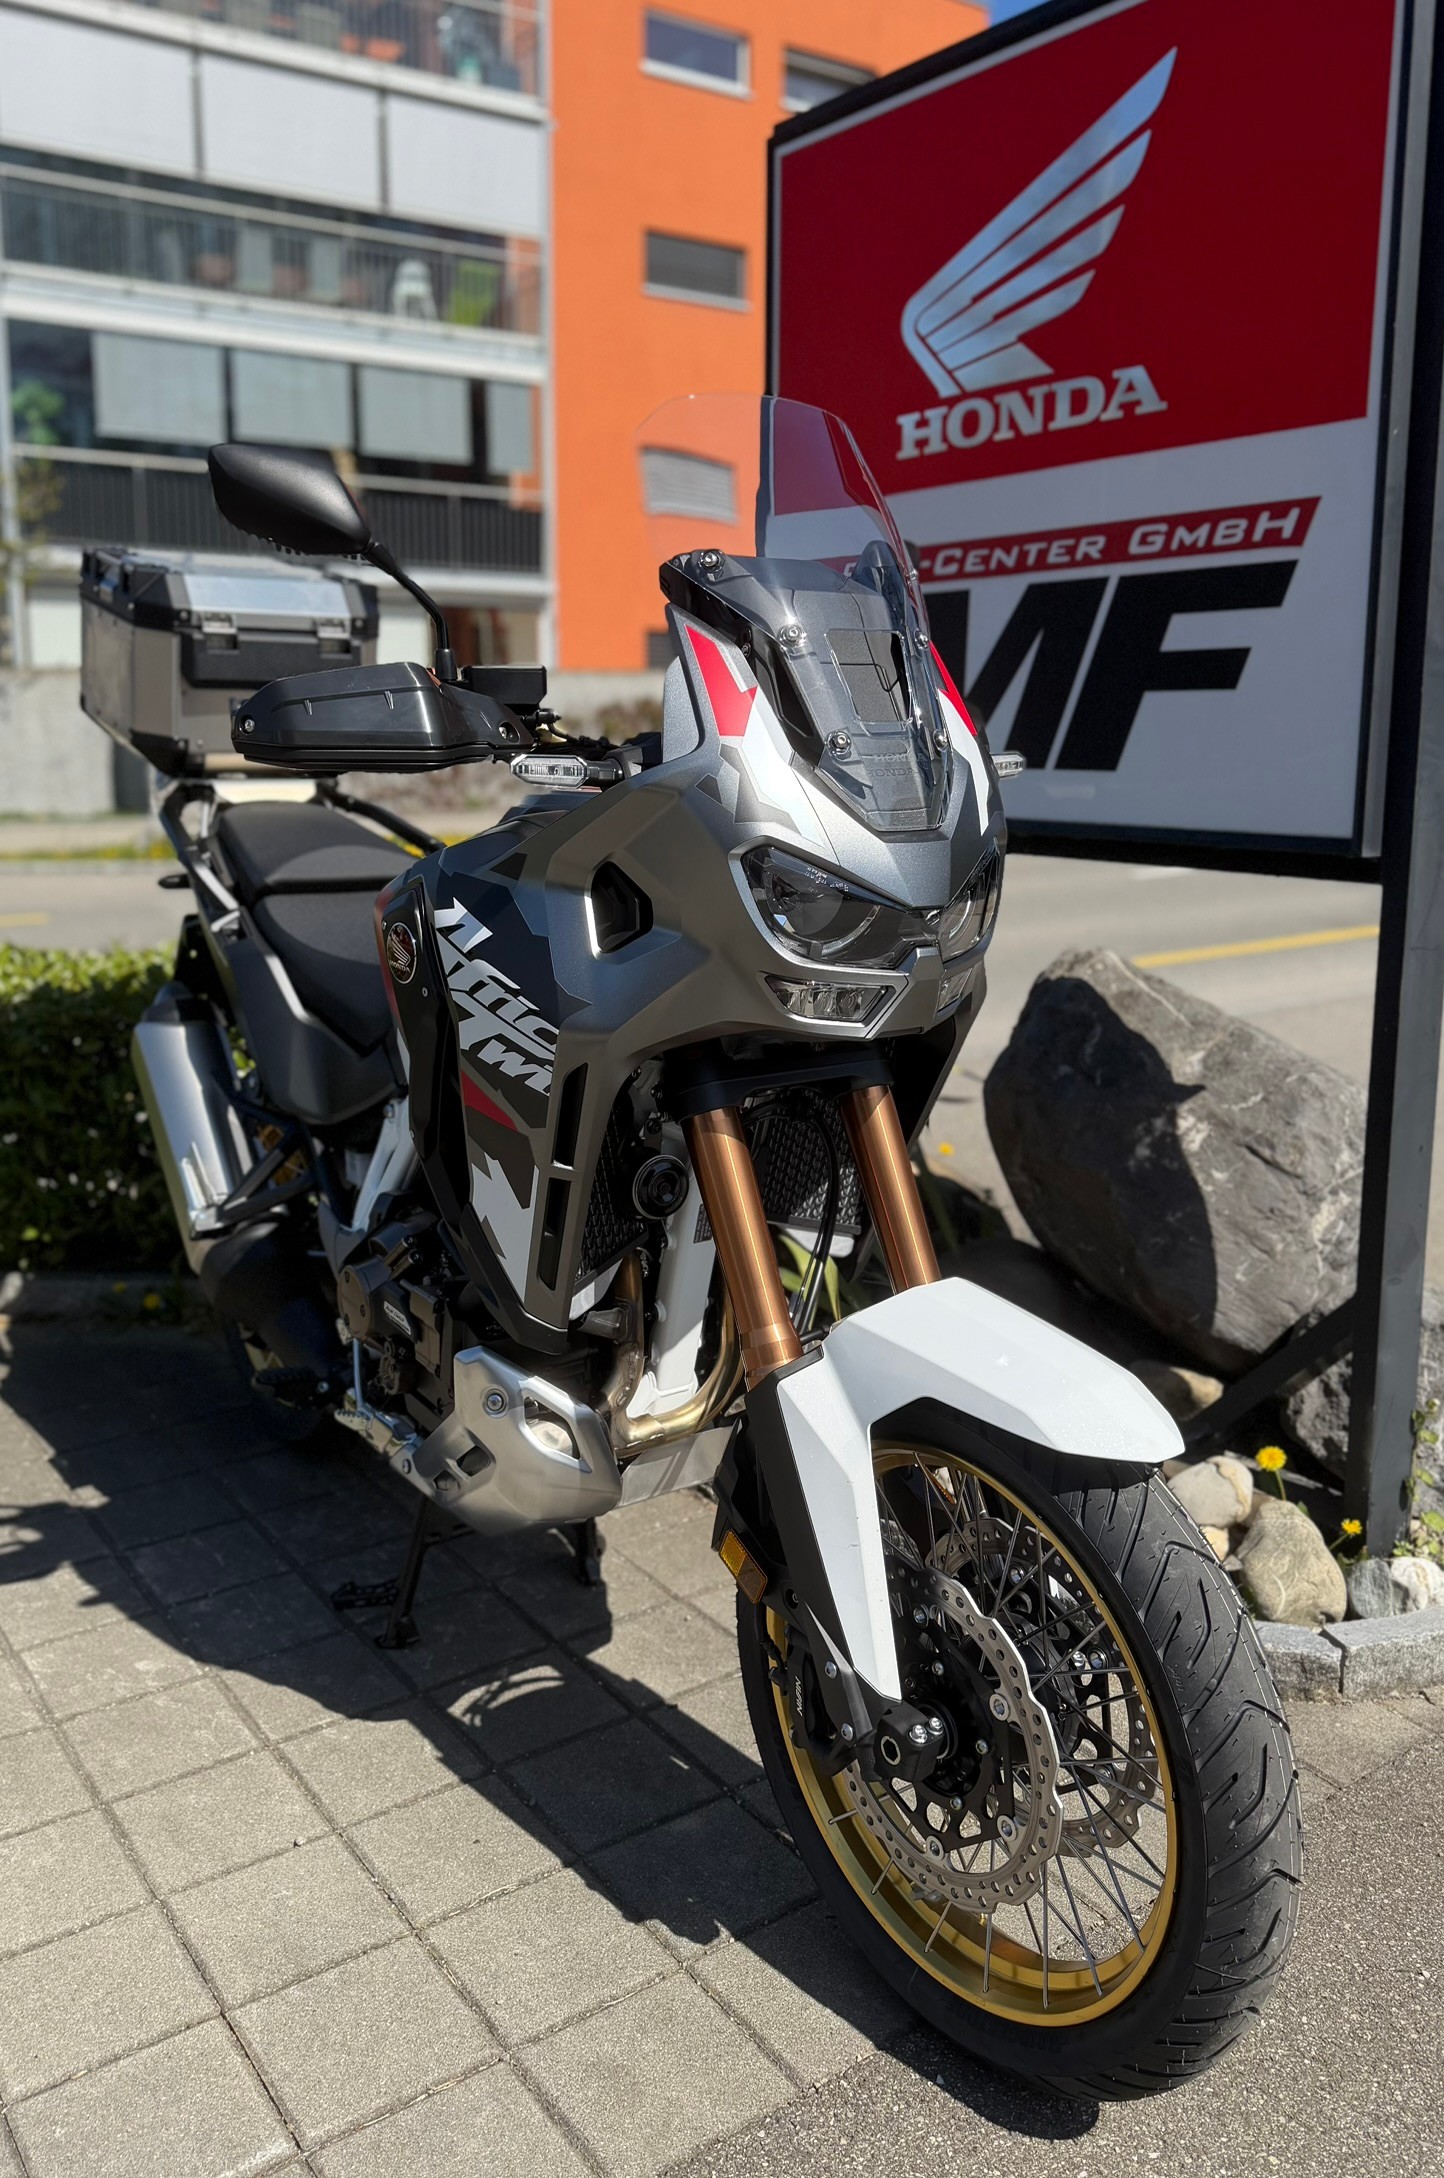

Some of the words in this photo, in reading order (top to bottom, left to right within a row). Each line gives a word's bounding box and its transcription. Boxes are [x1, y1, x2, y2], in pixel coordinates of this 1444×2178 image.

[896, 365, 1168, 460] HONDA
[843, 536, 1104, 577] -CENTER
[434, 897, 559, 1056] Afric
[450, 990, 555, 1097] Twi
